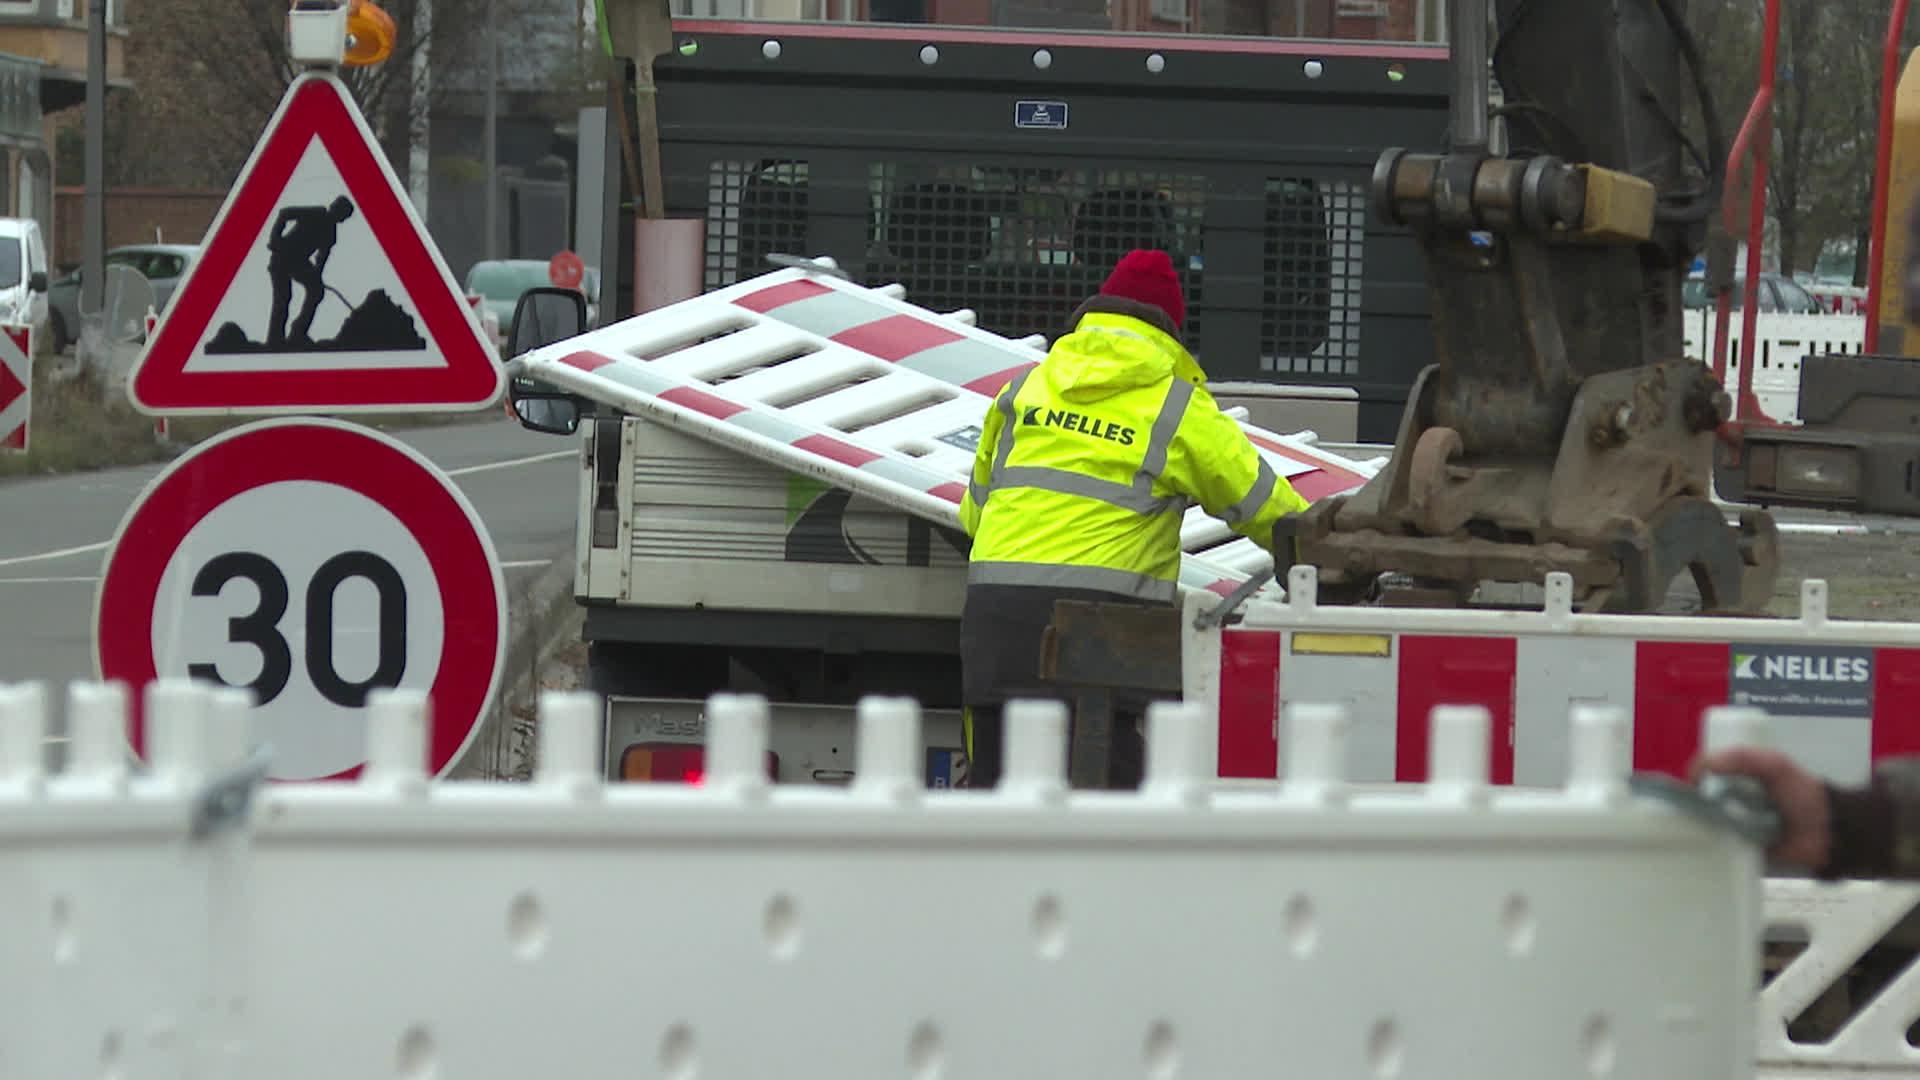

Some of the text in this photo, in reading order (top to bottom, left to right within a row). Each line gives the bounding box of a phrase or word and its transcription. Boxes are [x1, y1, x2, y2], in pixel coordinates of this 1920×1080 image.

[1045, 409, 1136, 445] NELLES
[188, 550, 407, 708] 30
[1763, 655, 1869, 682] NELLES
